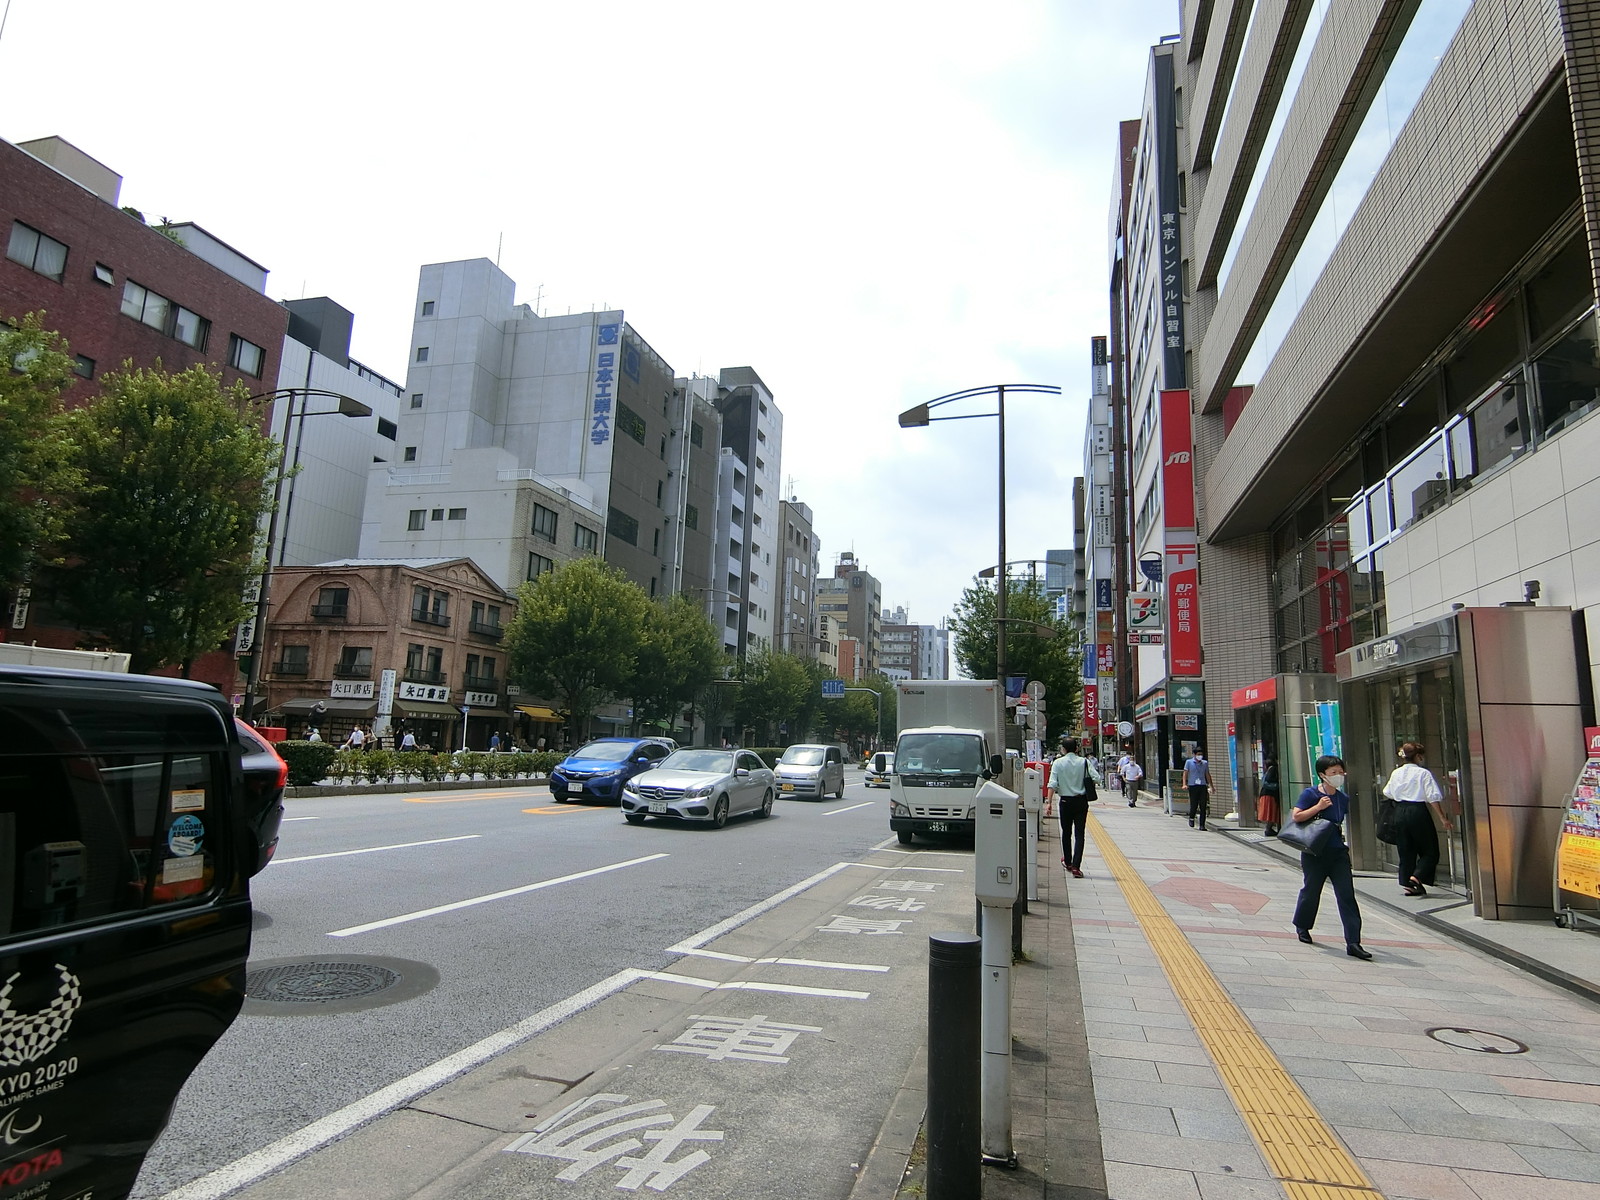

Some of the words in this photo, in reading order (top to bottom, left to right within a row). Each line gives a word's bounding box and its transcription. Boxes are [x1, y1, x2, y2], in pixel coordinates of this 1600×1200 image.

[1162, 212, 1180, 348] 東京レンタル自習室
[591, 352, 614, 446] 日本工業大学
[1165, 451, 1190, 466] JTB
[1177, 598, 1190, 633] 郵便局
[1151, 635, 1161, 643] ATM
[333, 683, 372, 695] 矢口書店
[405, 685, 447, 700] 矢口書店
[1087, 691, 1095, 719] ACCEA
[34, 1056, 78, 1086] 2020
[35, 1079, 65, 1096] GAMES
